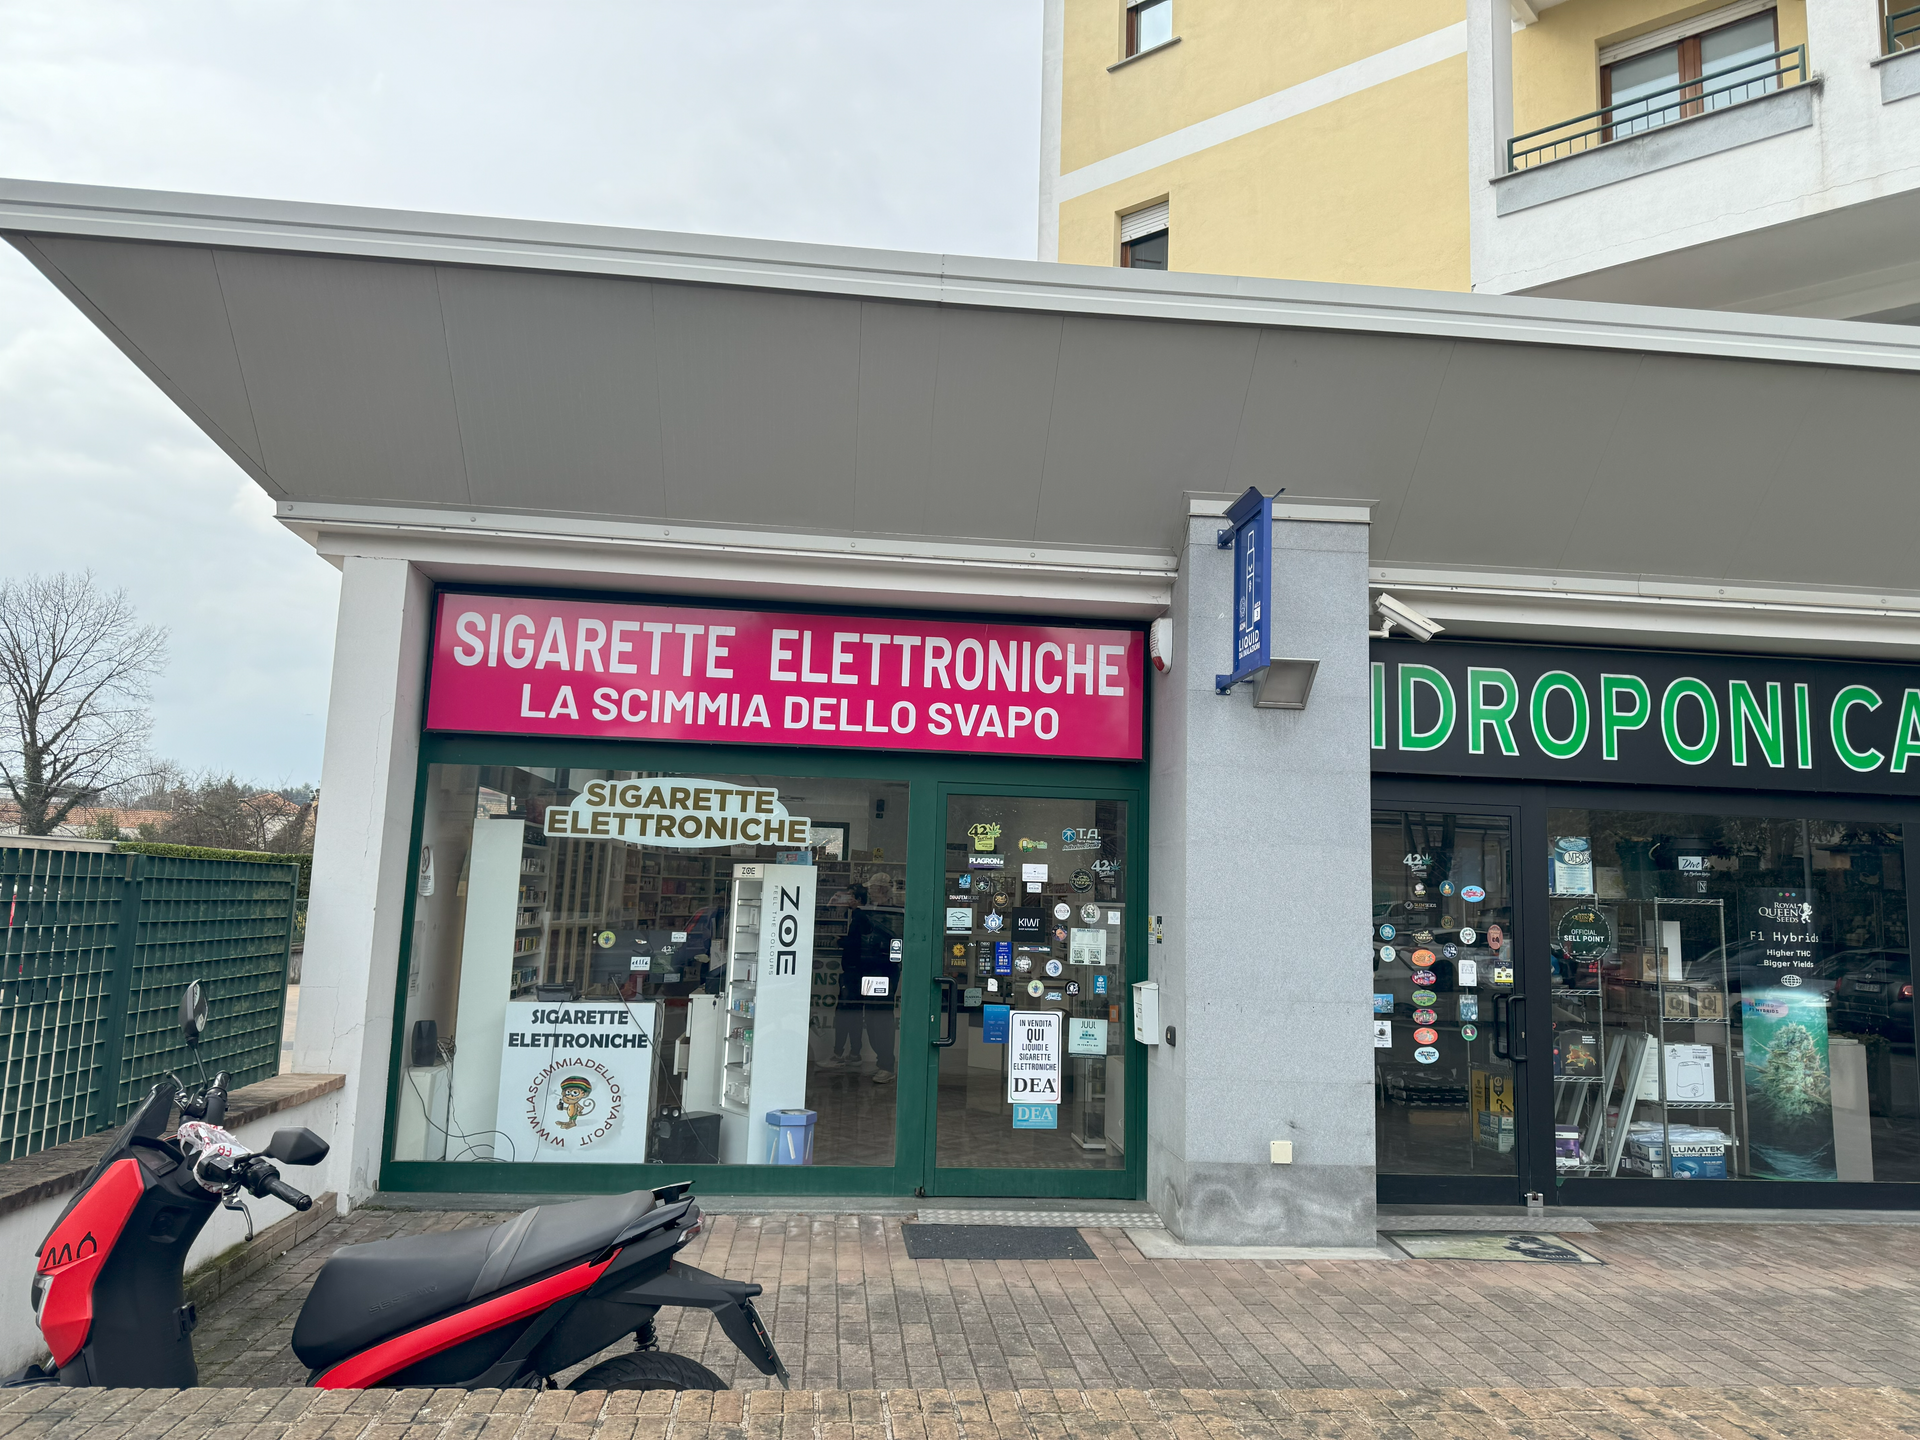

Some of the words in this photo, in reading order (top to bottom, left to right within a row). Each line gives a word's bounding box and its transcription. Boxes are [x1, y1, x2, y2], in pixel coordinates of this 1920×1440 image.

[453, 611, 737, 680] SIGARETTE
[770, 628, 1125, 697] ELETTRONICHE
[520, 683, 579, 721] LA
[592, 687, 772, 728] SCIMMIA
[783, 695, 918, 735] DELLO
[927, 702, 1060, 741] SVAPO
[1371, 661, 1920, 773] IDROPONICA
[586, 782, 775, 814] SIGARETTE
[547, 809, 808, 844] ELETTRONICHE
[969, 857, 1000, 865] PLAGRON
[741, 866, 756, 875] ZOE
[1774, 901, 1799, 909] ROYAL
[1758, 906, 1799, 919] QUEEN
[776, 885, 800, 976] ZOE
[1570, 928, 1597, 936] OFFICIAL
[1750, 930, 1765, 941] F1
[1773, 931, 1819, 945] Hybrids
[1582, 935, 1605, 943] POINT
[1766, 949, 1795, 958] Higher
[1763, 959, 1791, 968] Bigger
[1792, 960, 1814, 968] Yields
[531, 1009, 629, 1025] SIGARETTE
[1019, 1019, 1026, 1027] IN
[1027, 1019, 1052, 1028] VENDITA
[508, 1032, 648, 1049] ELETTRONICHE
[1026, 1028, 1044, 1043] QUI
[1022, 1043, 1044, 1052] LIQUIDI
[1018, 1053, 1052, 1061] SIGARETTE
[1013, 1062, 1057, 1071] ELETTRONICHE
[1013, 1077, 1056, 1093] DEA
[526, 1057, 622, 1148] WWW.LASCIMMIADELLOSVAPO.IT
[1016, 1106, 1053, 1120] DEA
